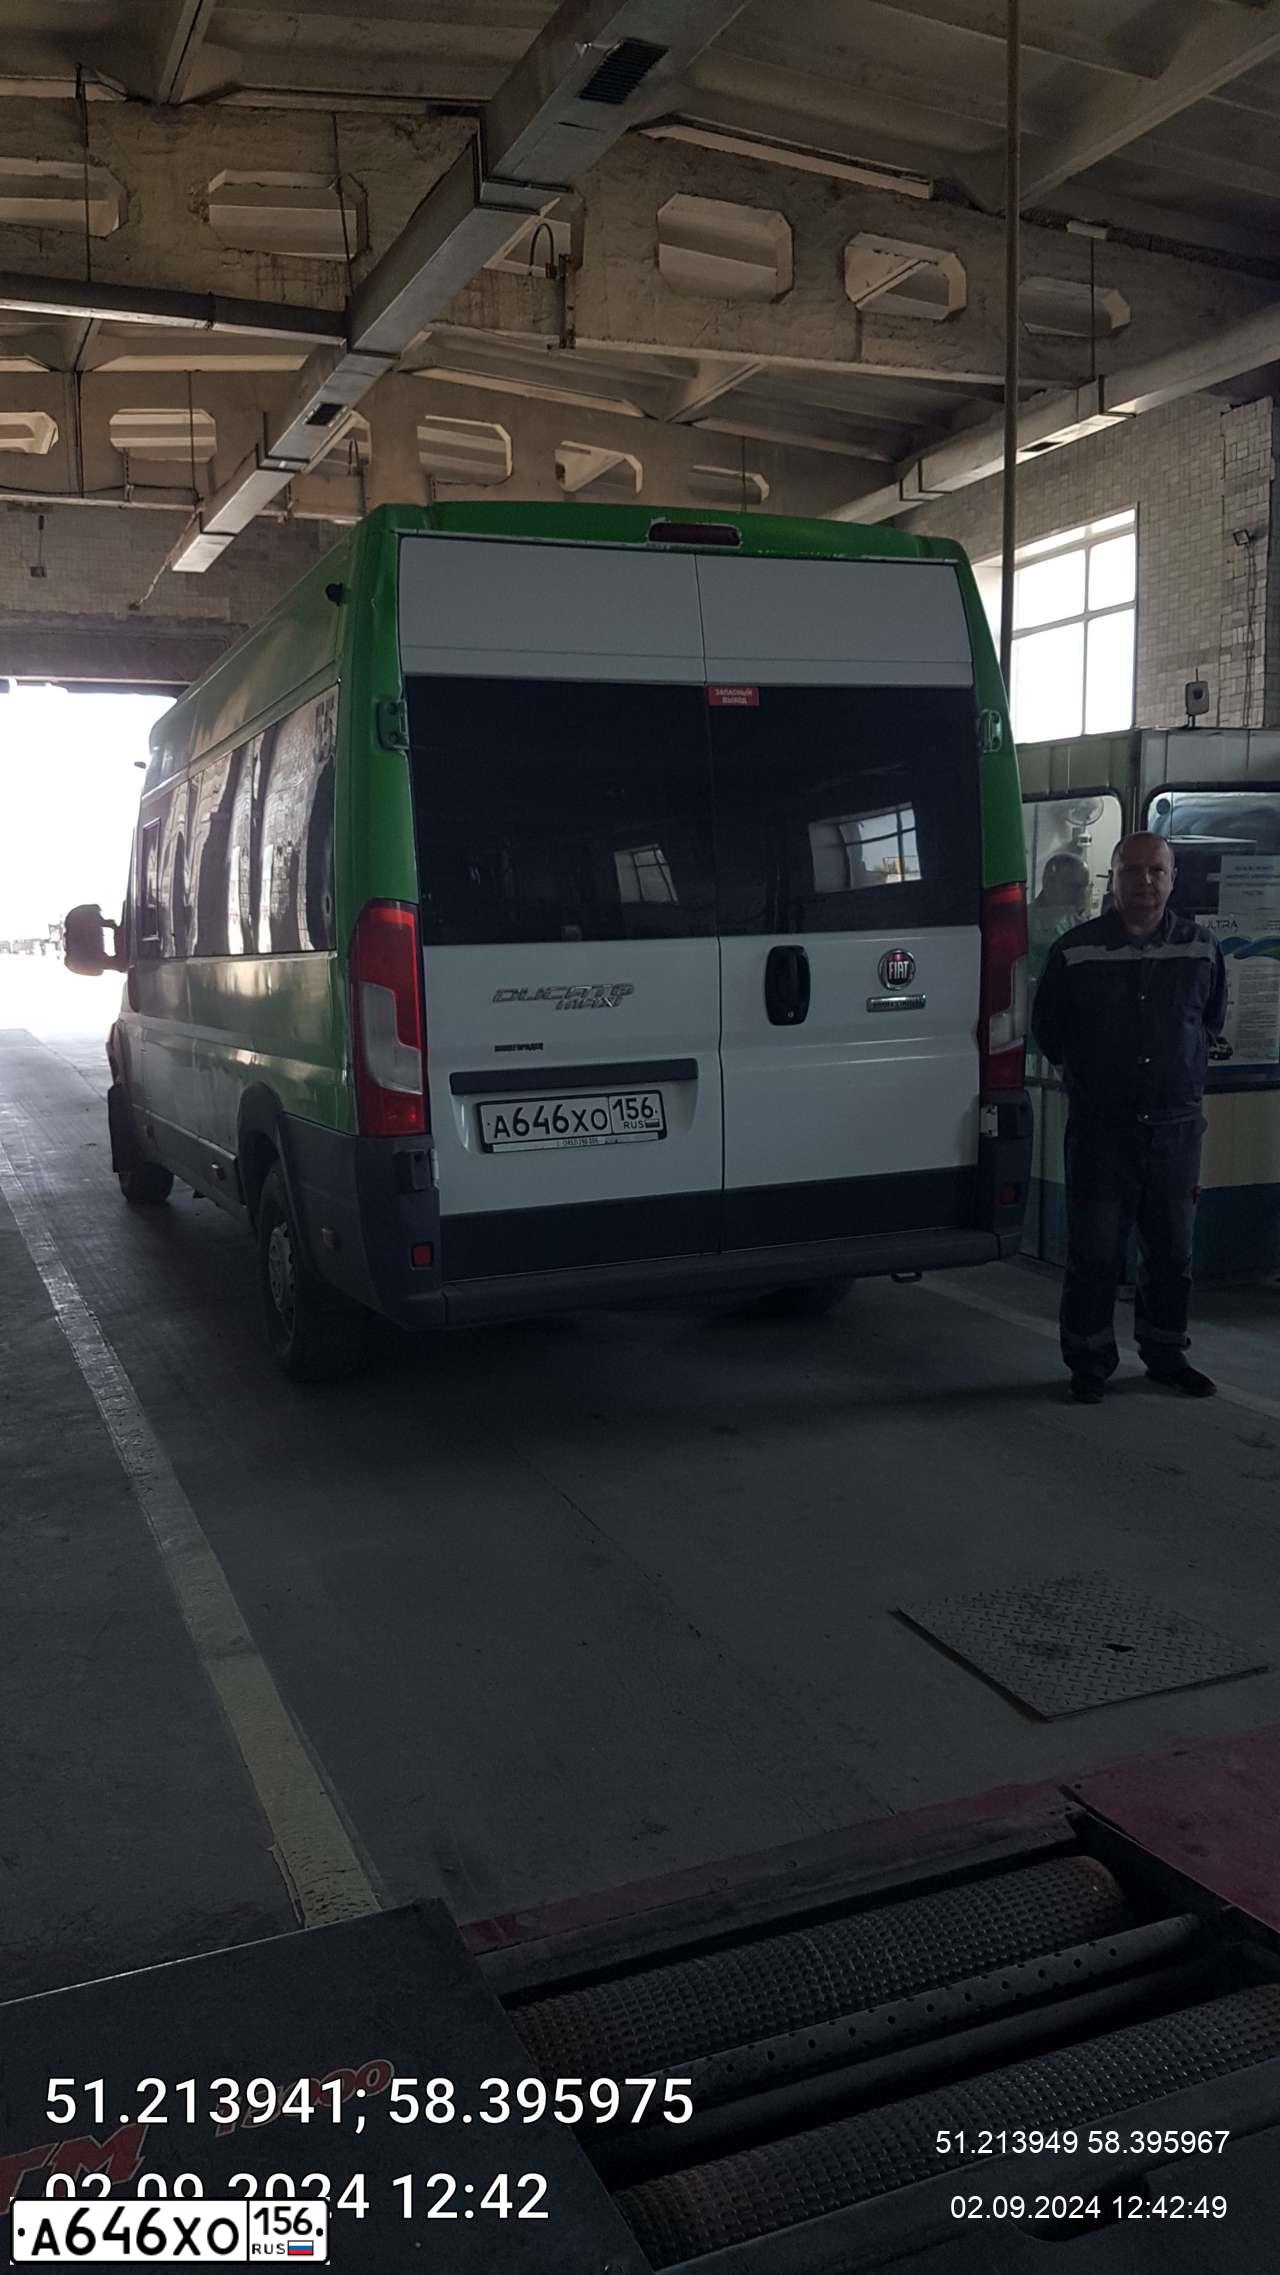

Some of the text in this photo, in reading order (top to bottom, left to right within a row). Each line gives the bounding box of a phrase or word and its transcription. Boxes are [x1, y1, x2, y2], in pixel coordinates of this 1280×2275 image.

[888, 960, 909, 980] FIAT
[493, 1097, 654, 1139] А646ХО 156
[623, 1119, 645, 1130] RUS
